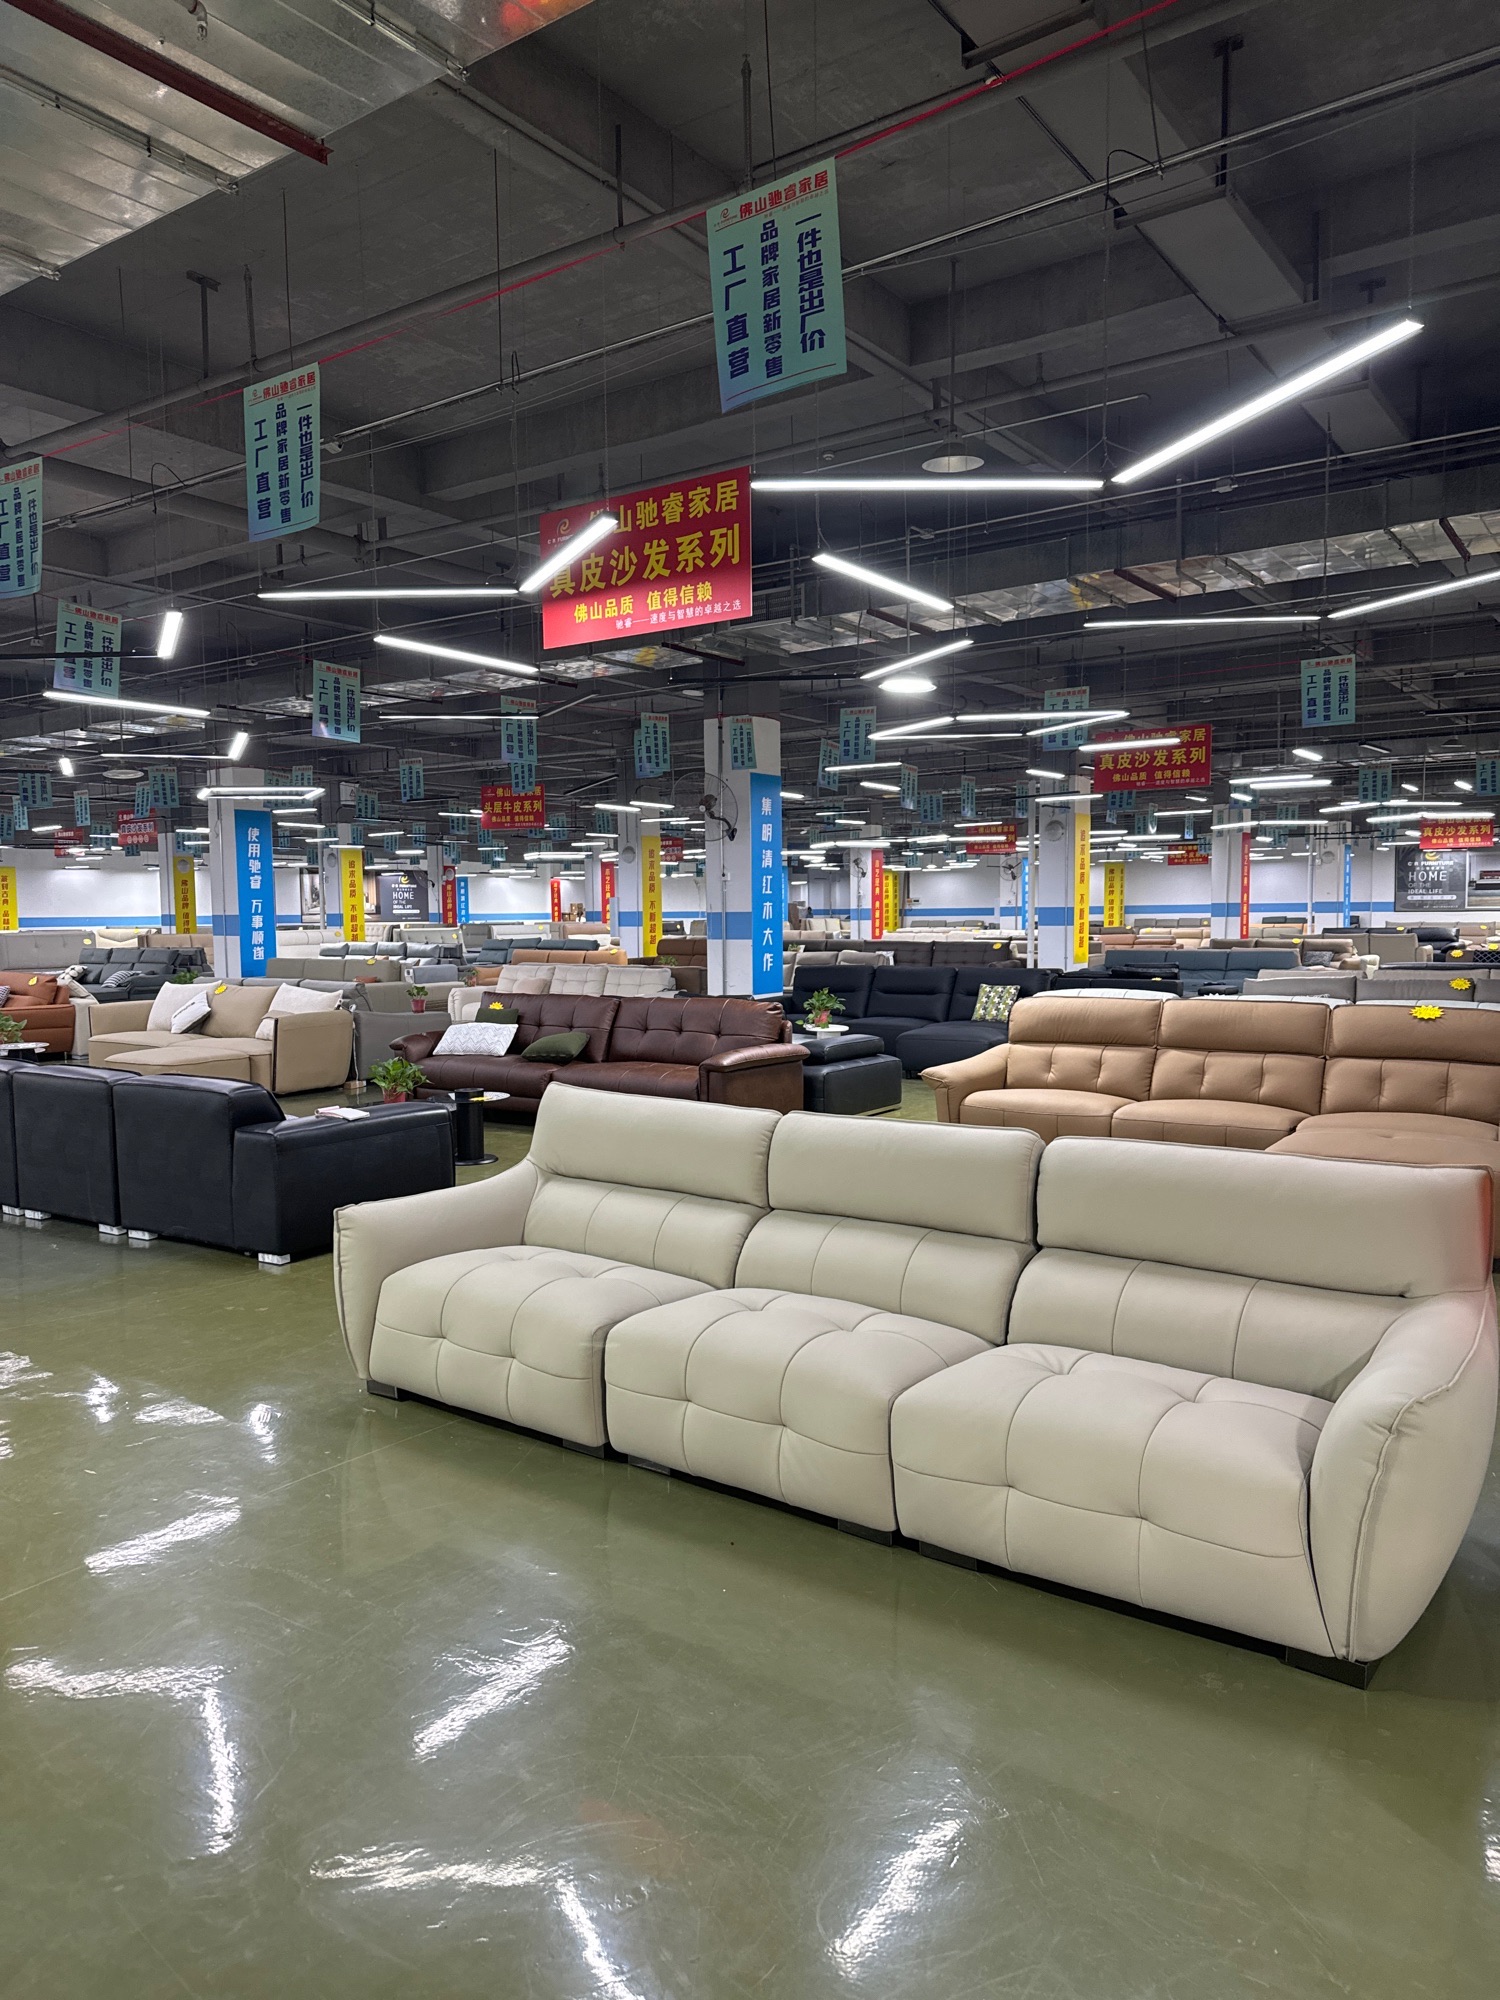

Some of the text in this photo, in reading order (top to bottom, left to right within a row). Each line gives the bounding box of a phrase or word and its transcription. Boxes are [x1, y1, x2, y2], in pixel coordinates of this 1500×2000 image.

[739, 169, 828, 219] 佛山驰睿家居
[759, 219, 783, 379] 品牌家居新零售
[795, 213, 826, 354] 一件也是出厂价
[723, 243, 749, 380] 工厂直营
[262, 371, 316, 399] 佛山驰睿家居
[254, 418, 271, 520] 工厂直营
[275, 402, 291, 524] 品牌家居新零售
[296, 403, 314, 509] 一件也是出厂价
[589, 479, 740, 534] 山驰睿家居
[574, 581, 713, 624] 佛山品质 值得信赖
[1099, 746, 1206, 771] 真皮沙发系列
[1112, 772, 1147, 783] 佛山品质
[483, 800, 542, 814] 头层牛皮系列
[1423, 824, 1491, 837] 真皮沙发系列
[247, 827, 265, 960] 使用驰睿 万事顺遂
[392, 891, 415, 900] HOME
[761, 796, 774, 972] 集明清红木大作
[1408, 870, 1448, 881] HOME
